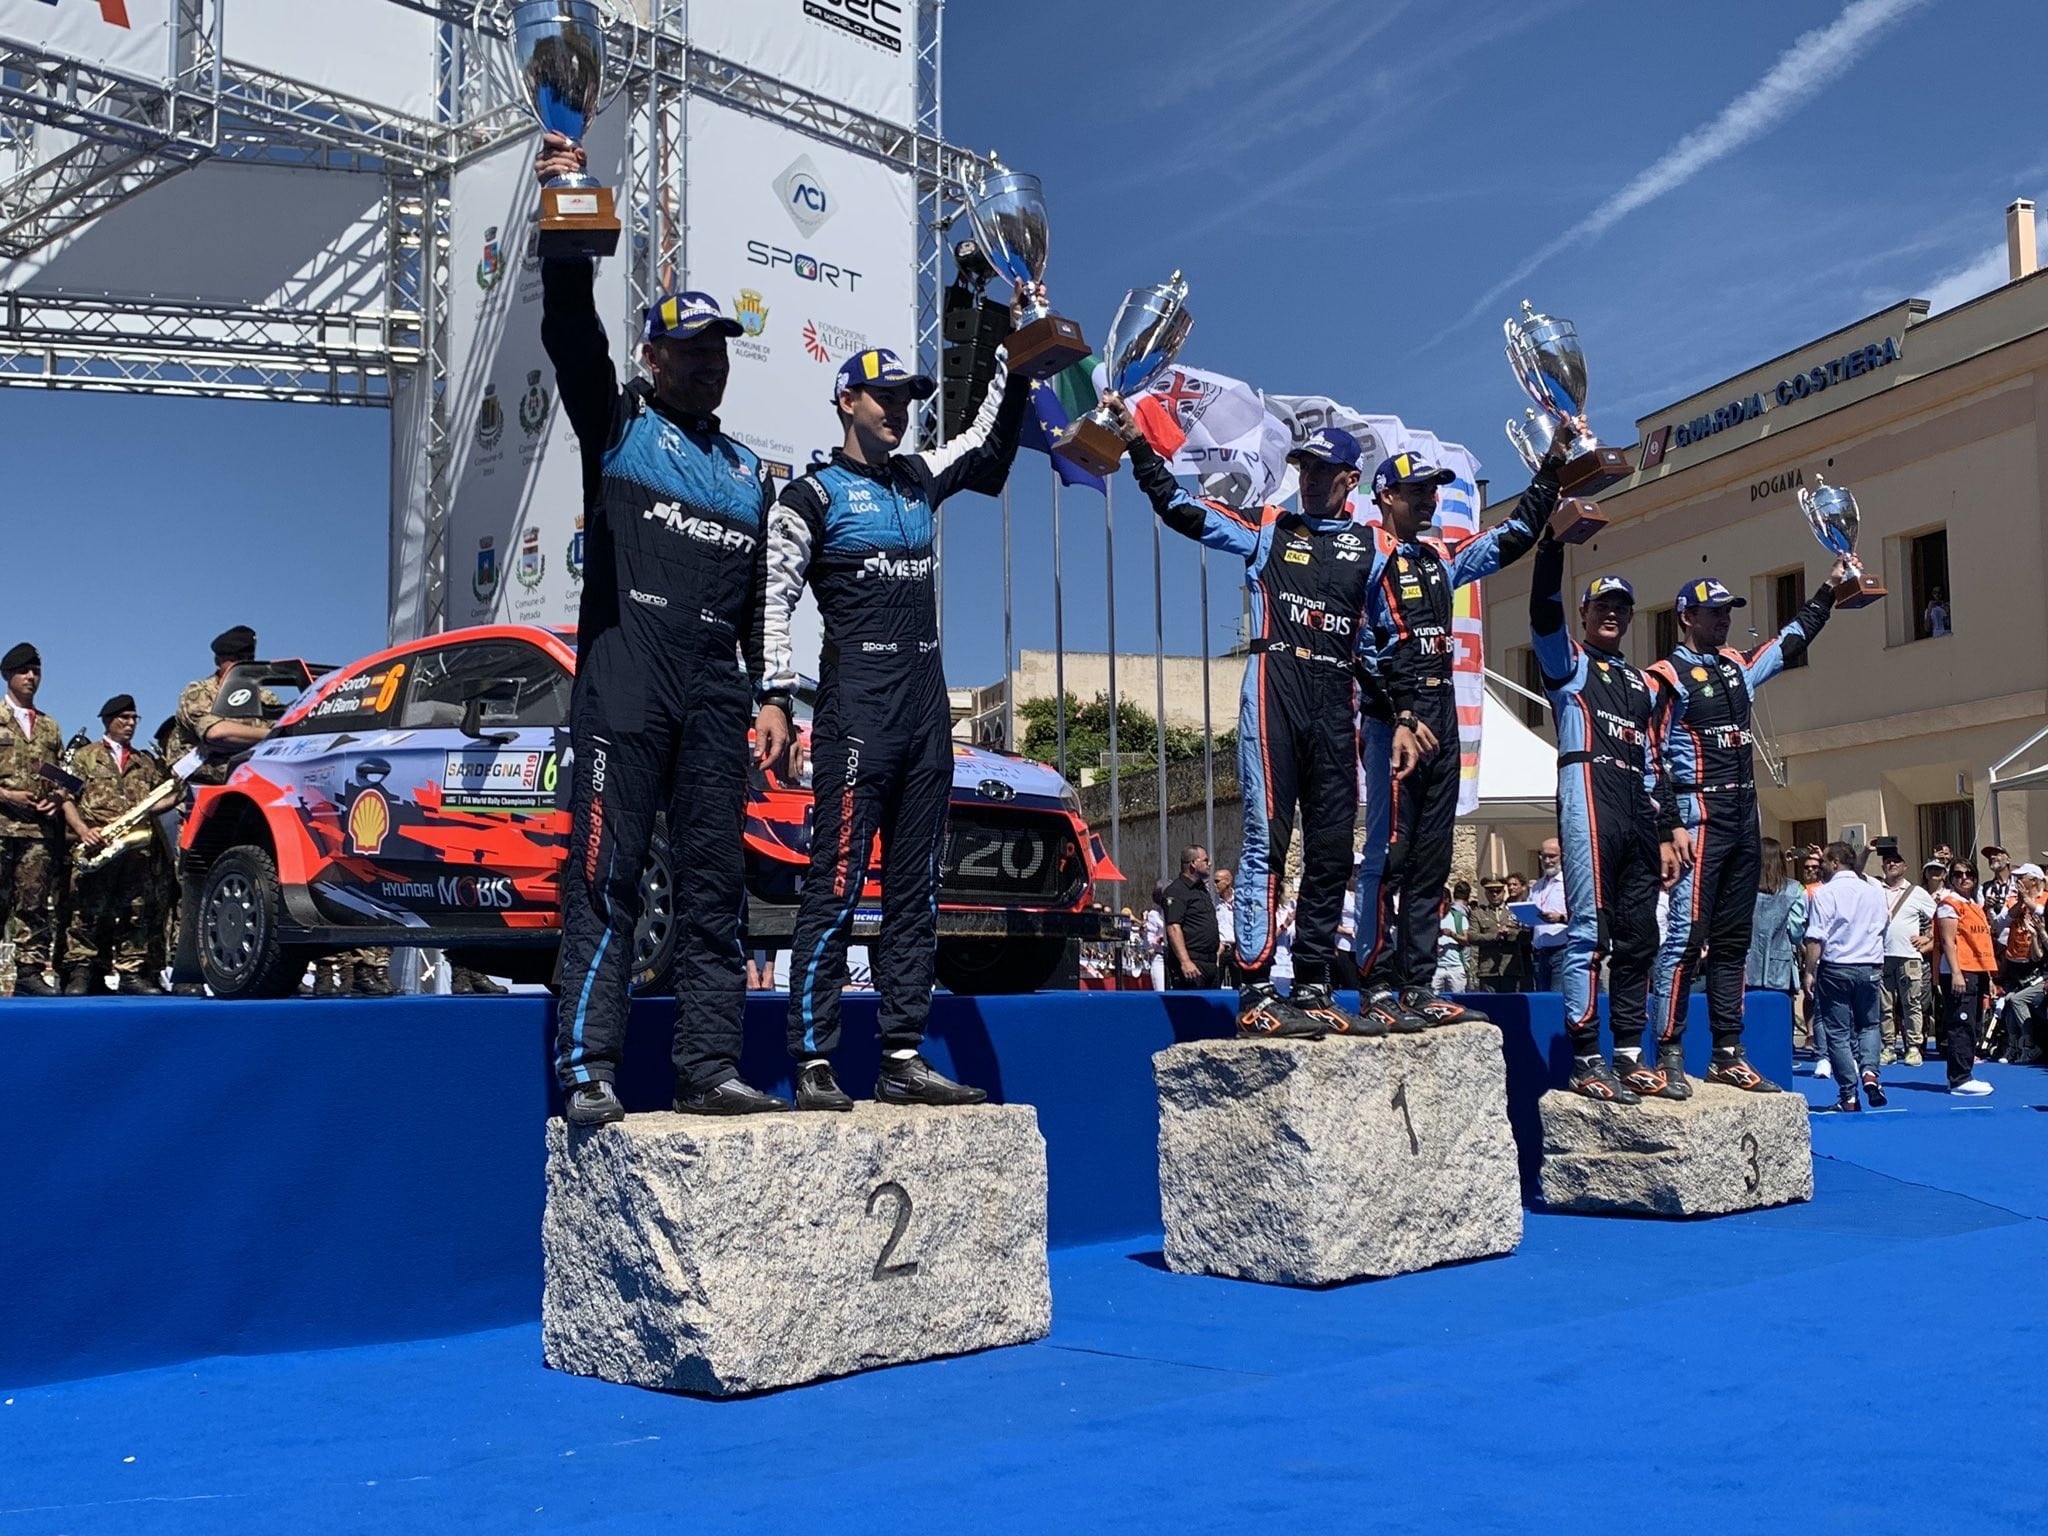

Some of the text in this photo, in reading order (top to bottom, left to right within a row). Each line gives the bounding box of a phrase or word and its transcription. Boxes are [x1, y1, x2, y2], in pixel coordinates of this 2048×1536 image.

[805, 4, 822, 16] FIA
[824, 9, 862, 33] WORLD
[863, 28, 900, 50] RALLY
[793, 184, 826, 212] ACI
[747, 240, 862, 292] SPORT
[732, 338, 759, 353] COMUNE
[818, 321, 867, 342] FONDAZIONE
[736, 349, 768, 363] ALGHERO
[1675, 336, 1902, 448] GUARDIA COSTIERA
[746, 434, 769, 449] Global
[1751, 469, 1804, 502] DOGANA
[1290, 604, 1351, 636] MOBIS
[338, 674, 371, 693] Sordo
[375, 663, 405, 713] 6
[317, 699, 334, 716] Del
[447, 763, 522, 778] SARDEGNA
[523, 754, 538, 787] 2019
[544, 752, 558, 792] 6
[593, 747, 607, 793] FORD
[845, 747, 860, 787] FORD
[382, 876, 513, 908] HYUNDAI MOBIS
[1392, 1083, 1418, 1156] 1
[1741, 1132, 1761, 1195] 3
[865, 1181, 919, 1281] 2
